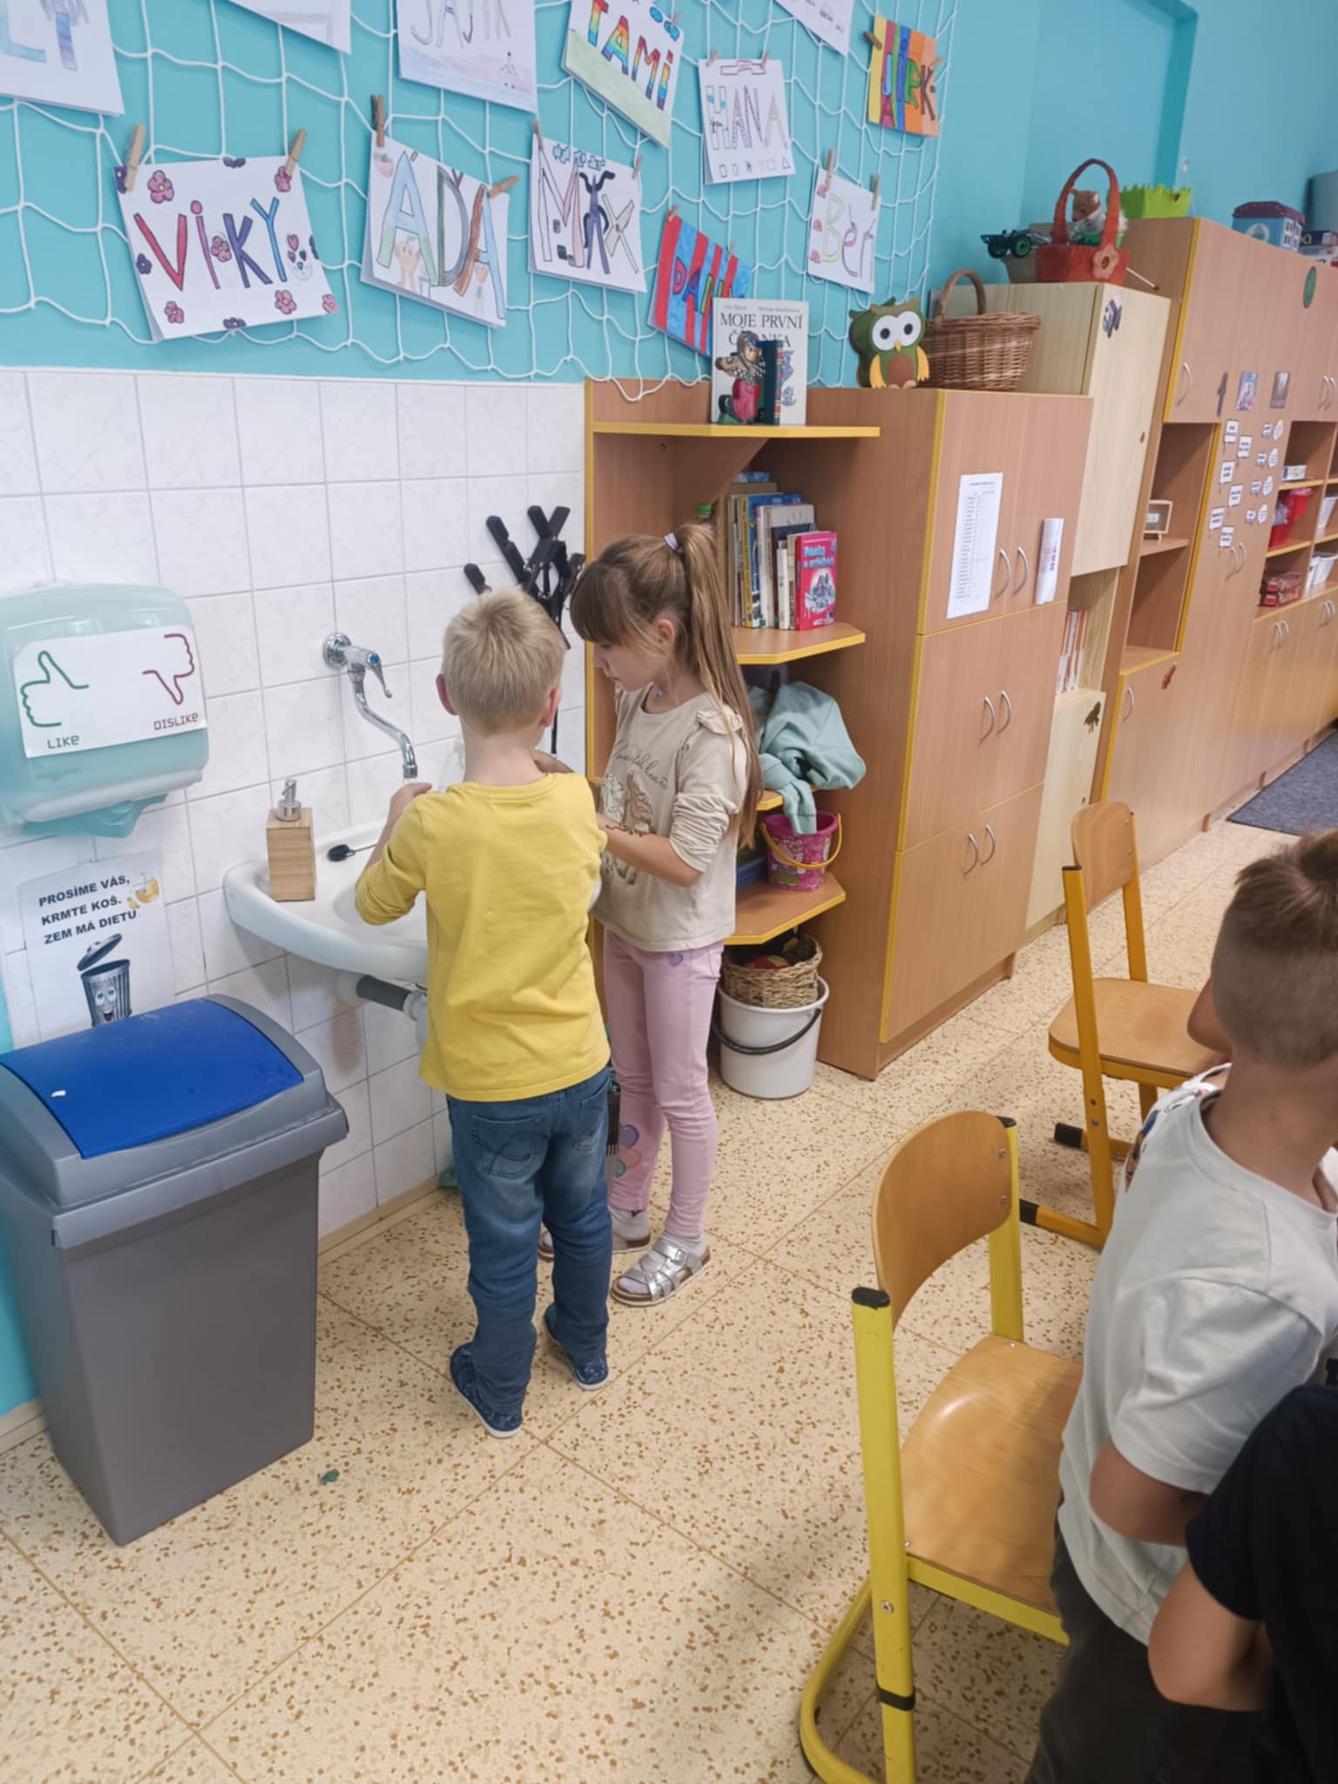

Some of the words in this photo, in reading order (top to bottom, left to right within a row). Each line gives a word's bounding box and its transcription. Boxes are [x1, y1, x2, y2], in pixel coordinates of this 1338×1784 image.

[704, 84, 790, 152] HANA
[720, 312, 758, 329] MOJE
[761, 312, 805, 330] PRVNÍ
[38, 882, 98, 907] PROSÍME
[100, 875, 131, 890] VÁS,
[41, 904, 89, 926] KRMTE
[91, 896, 122, 912] KOŠ.
[44, 928, 73, 945] ZEM
[75, 920, 96, 936] MÁ
[98, 909, 137, 929] DIETU
